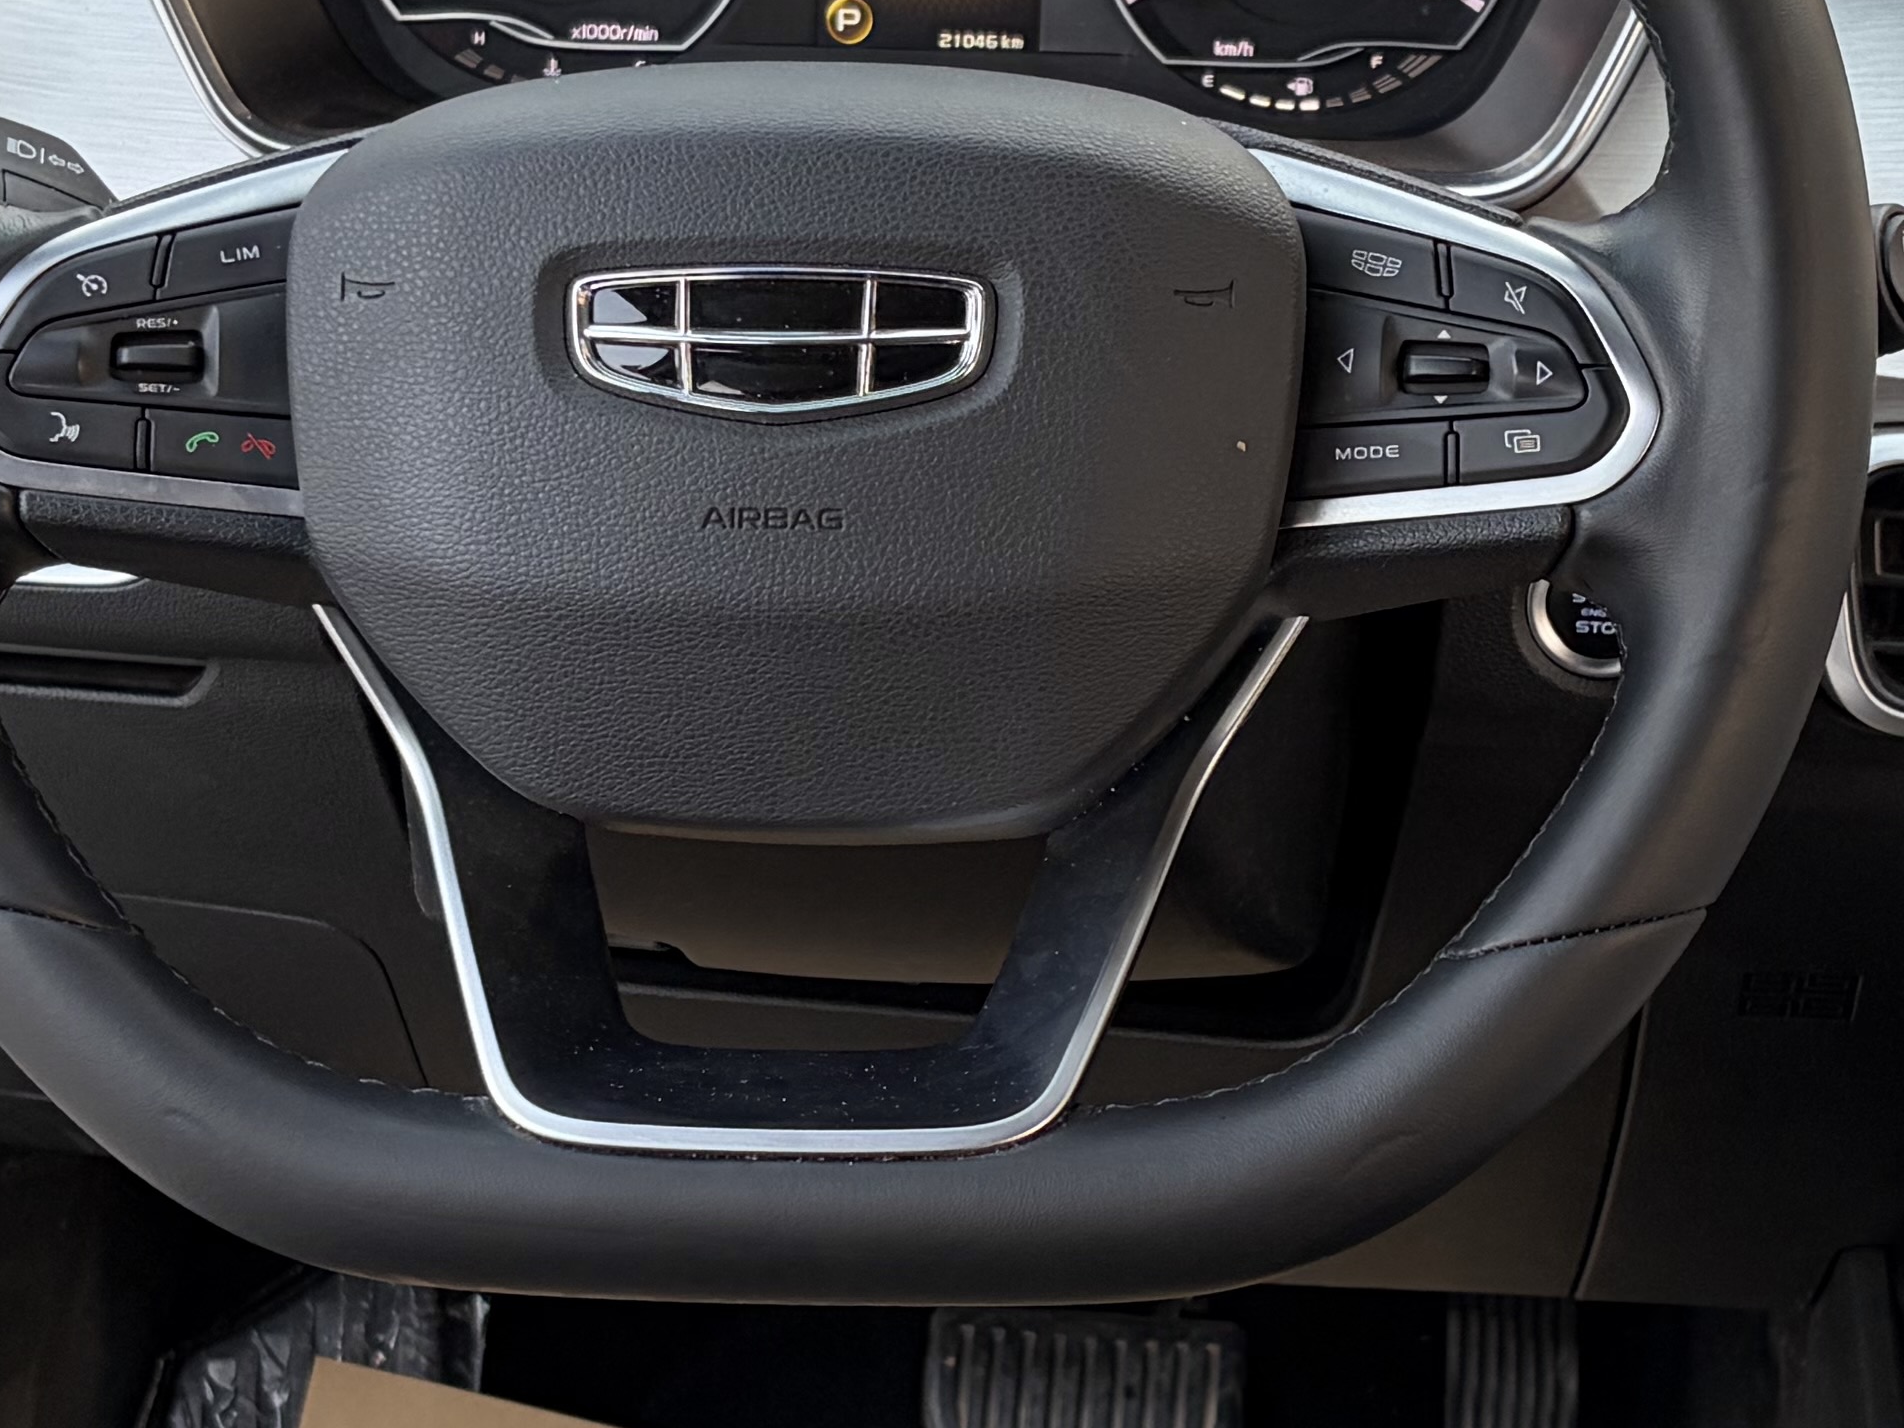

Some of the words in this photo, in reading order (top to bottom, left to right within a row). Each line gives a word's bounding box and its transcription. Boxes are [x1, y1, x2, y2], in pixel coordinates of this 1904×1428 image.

[837, 8, 861, 32] P
[1000, 34, 1024, 49] km
[1213, 40, 1254, 57] km/h
[1372, 56, 1383, 69] F
[1202, 74, 1214, 88] E
[220, 245, 259, 263] LIM
[1335, 444, 1400, 460] MODE
[701, 506, 844, 531] AIRBAG
